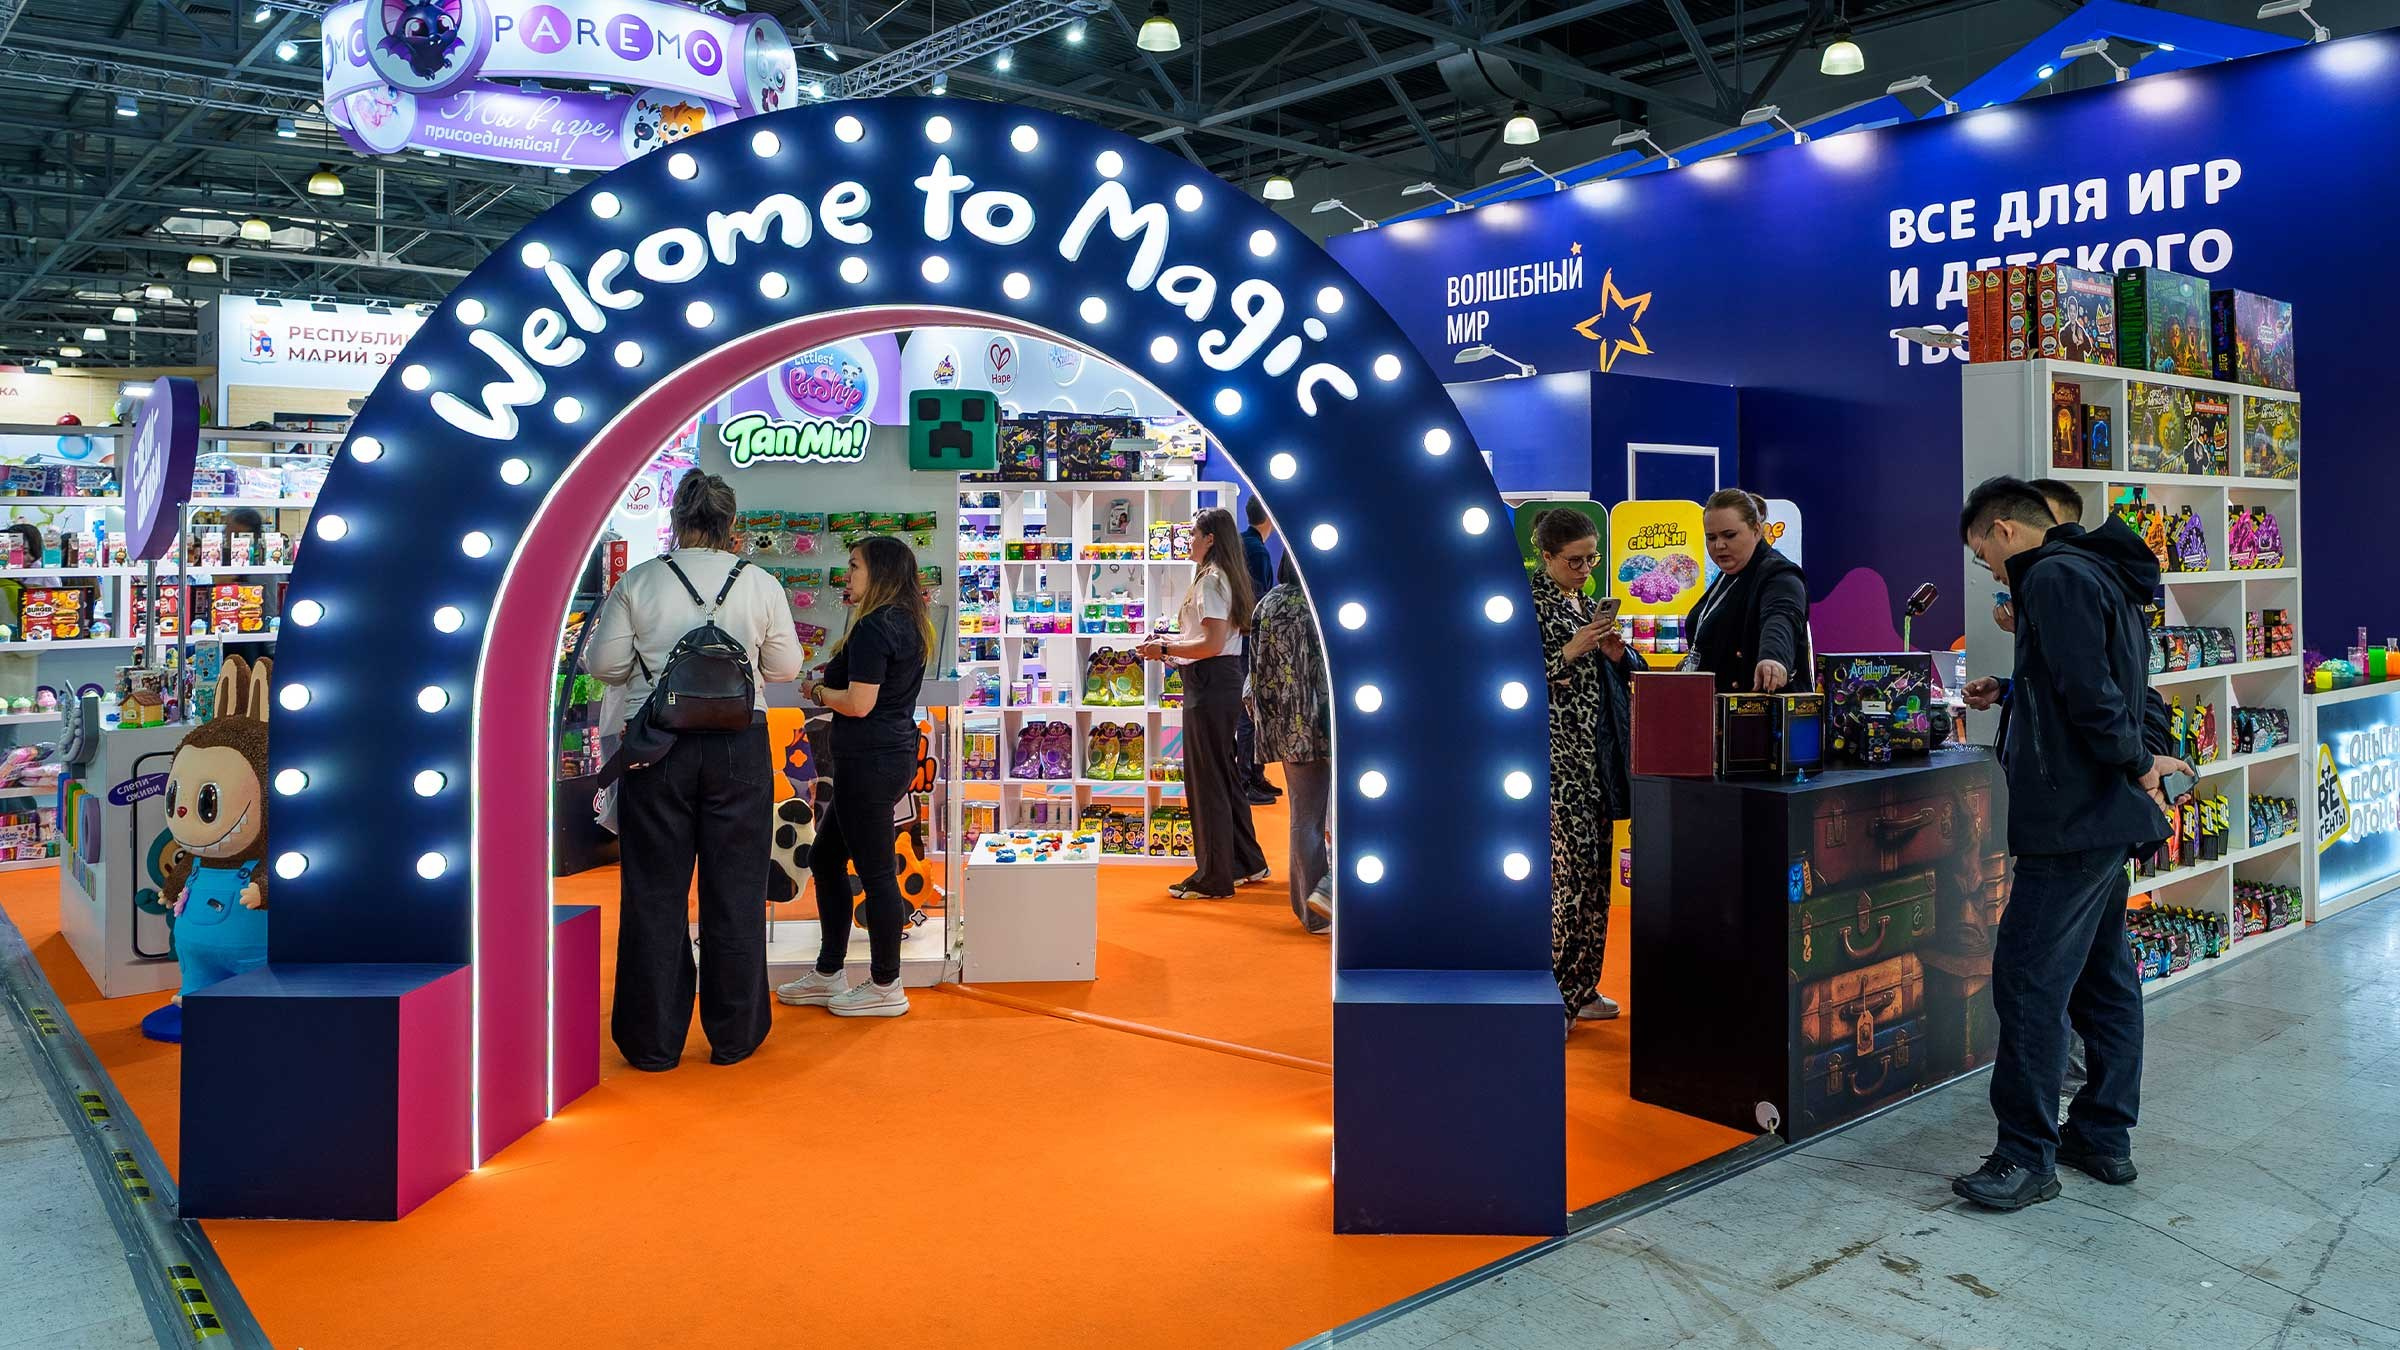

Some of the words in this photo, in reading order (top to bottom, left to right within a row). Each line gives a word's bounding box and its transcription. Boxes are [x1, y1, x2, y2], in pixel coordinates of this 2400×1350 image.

[495, 15, 716, 67] PAREMO
[440, 90, 521, 128] Мы
[526, 95, 562, 131] в
[425, 124, 560, 153] присоединяйся!
[1889, 198, 1976, 249] ВСЕ
[1993, 178, 2107, 242] ДЛЯ
[2127, 158, 2242, 215] ИГР
[1447, 243, 1583, 307] ВОЛШЕБНЫЙ
[1889, 267, 1919, 307] И
[431, 180, 872, 441] Welcome
[915, 154, 1034, 243] to
[1059, 179, 1357, 415] Magic
[288, 326, 409, 346] РЕСПУБЛИ
[1447, 310, 1490, 344] МИР
[288, 346, 367, 364] МАРИЙ
[991, 373, 1011, 385] Hape
[1848, 661, 1892, 679] Academy
[2351, 761, 2400, 801] ПРОСТ
[2318, 808, 2346, 841] ГЕНТЫ
